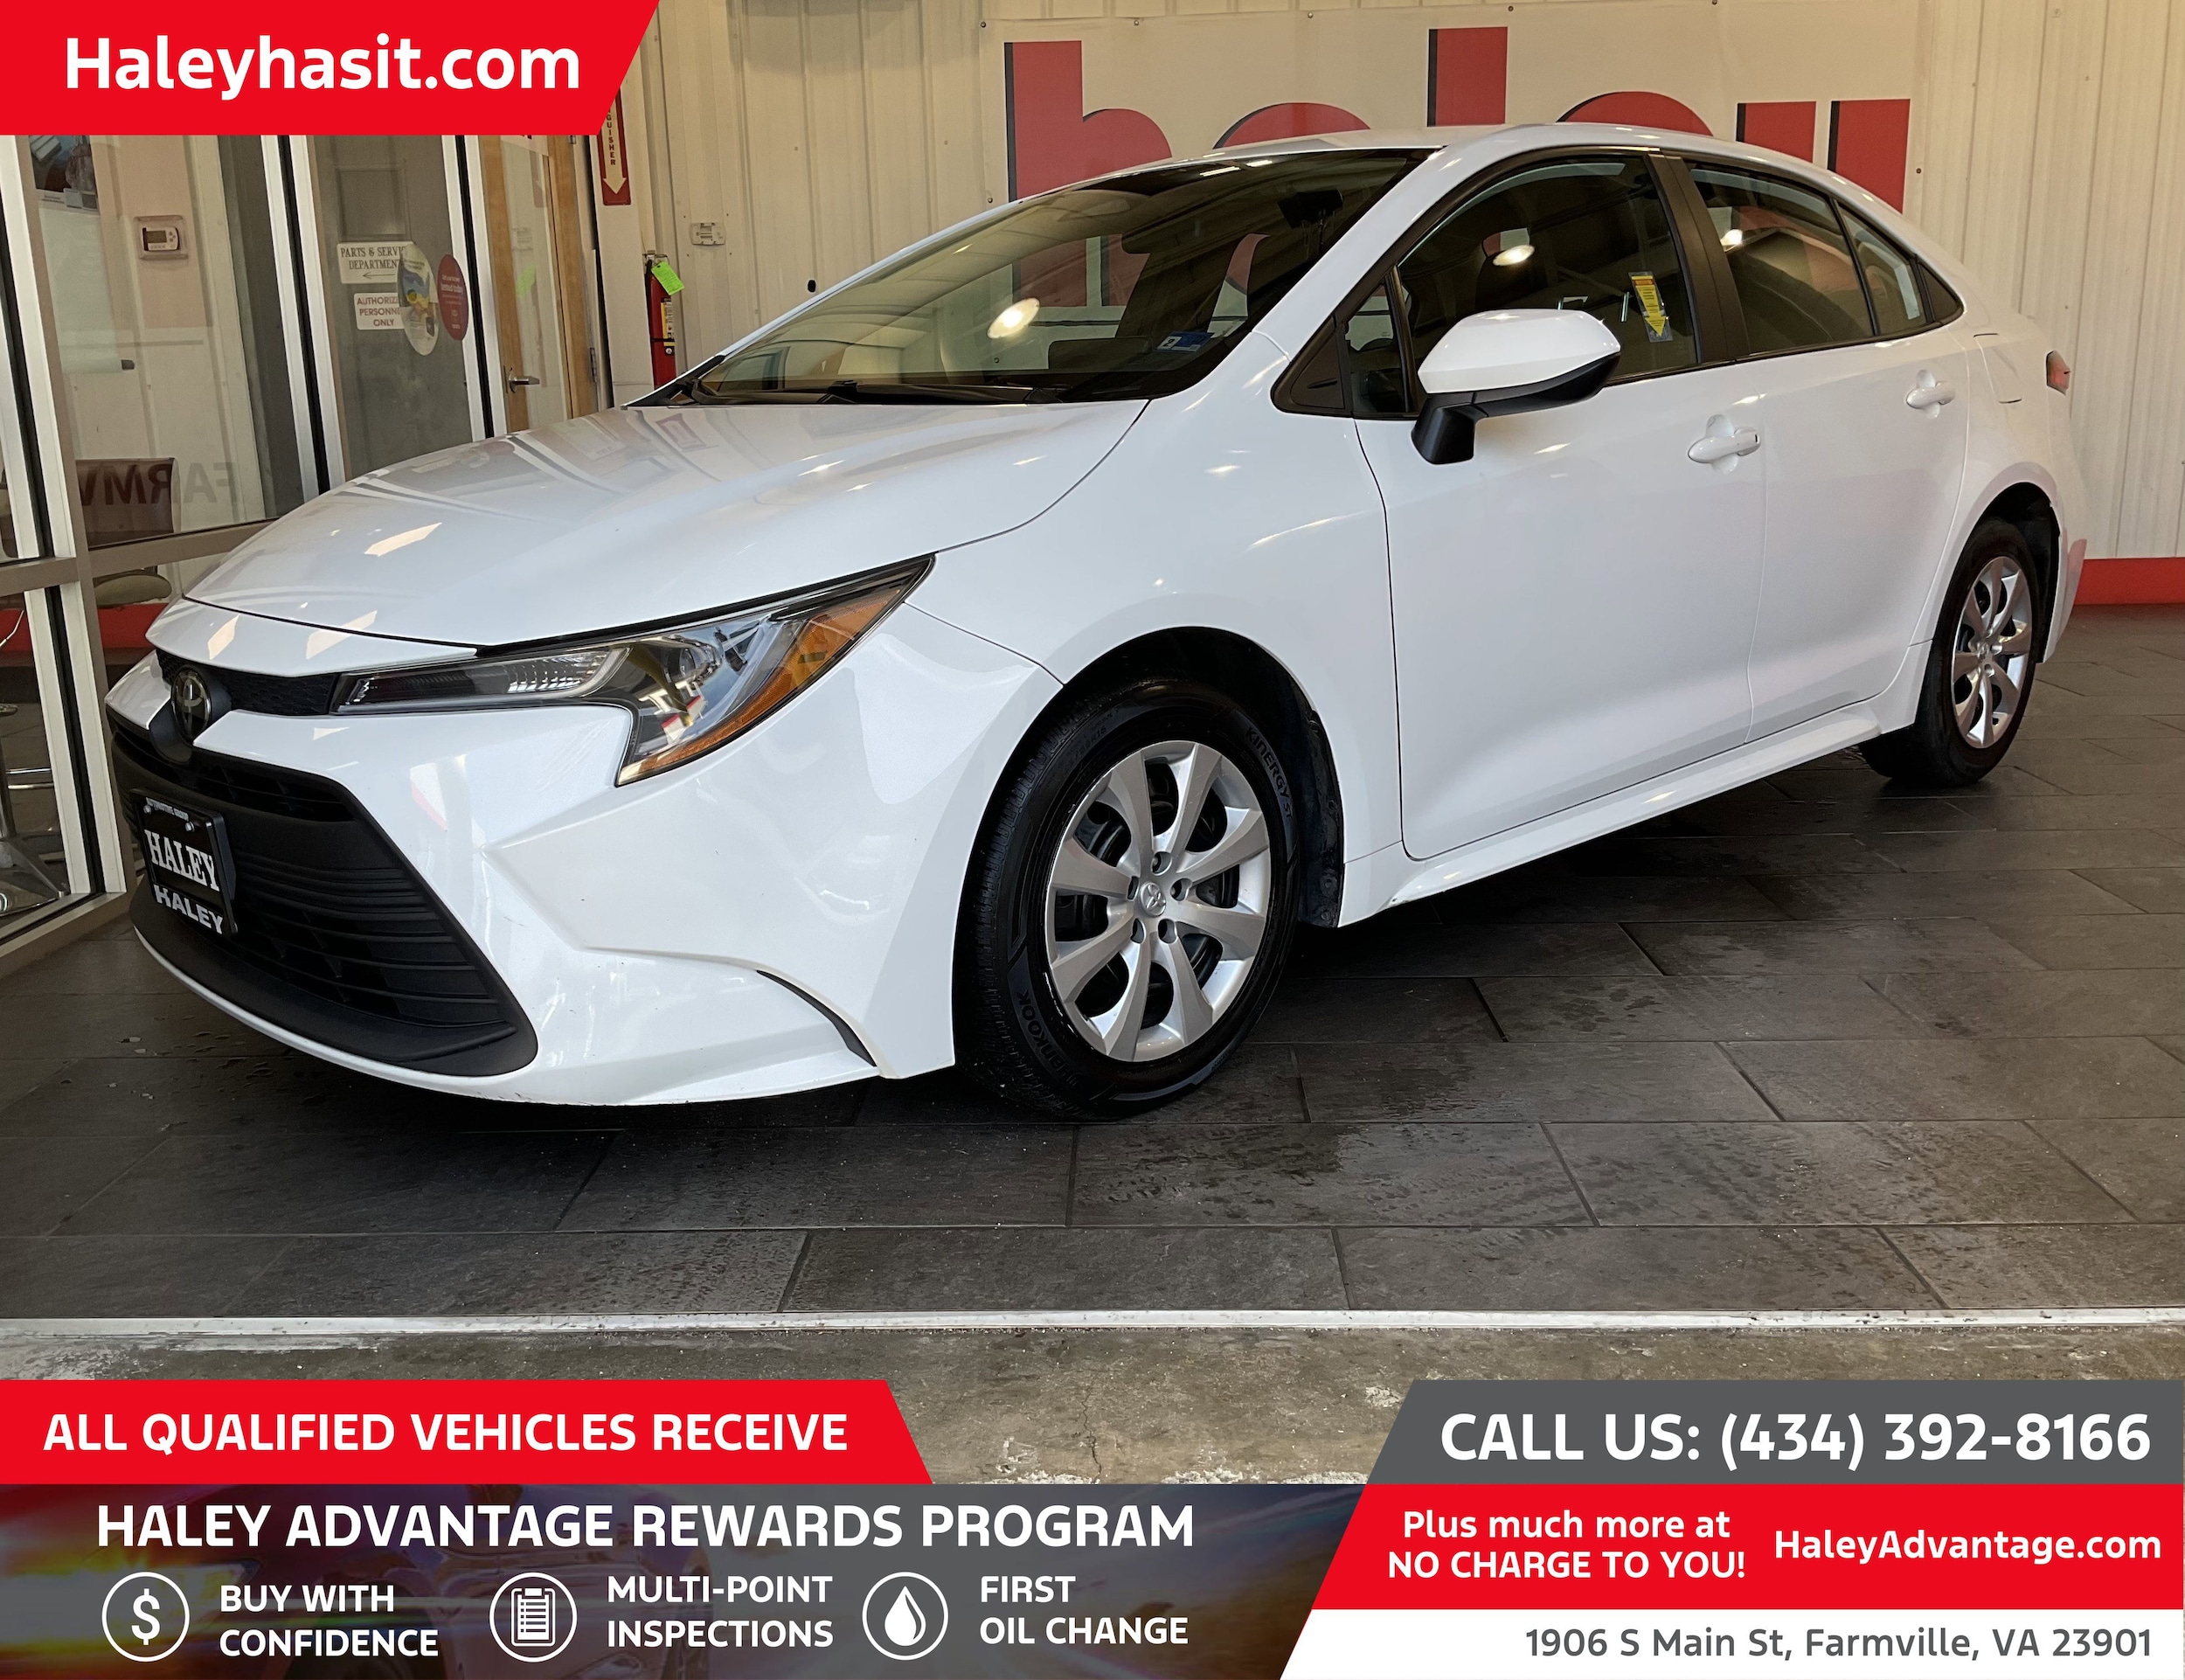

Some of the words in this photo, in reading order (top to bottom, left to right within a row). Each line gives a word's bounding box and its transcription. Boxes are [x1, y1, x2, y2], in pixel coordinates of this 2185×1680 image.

[341, 246, 366, 258] PARTS
[369, 246, 375, 257] &
[357, 295, 399, 304] AUTHORIZE
[359, 308, 401, 316] PERSONNE
[144, 830, 220, 892] HALEY
[154, 884, 223, 934] HALEY
